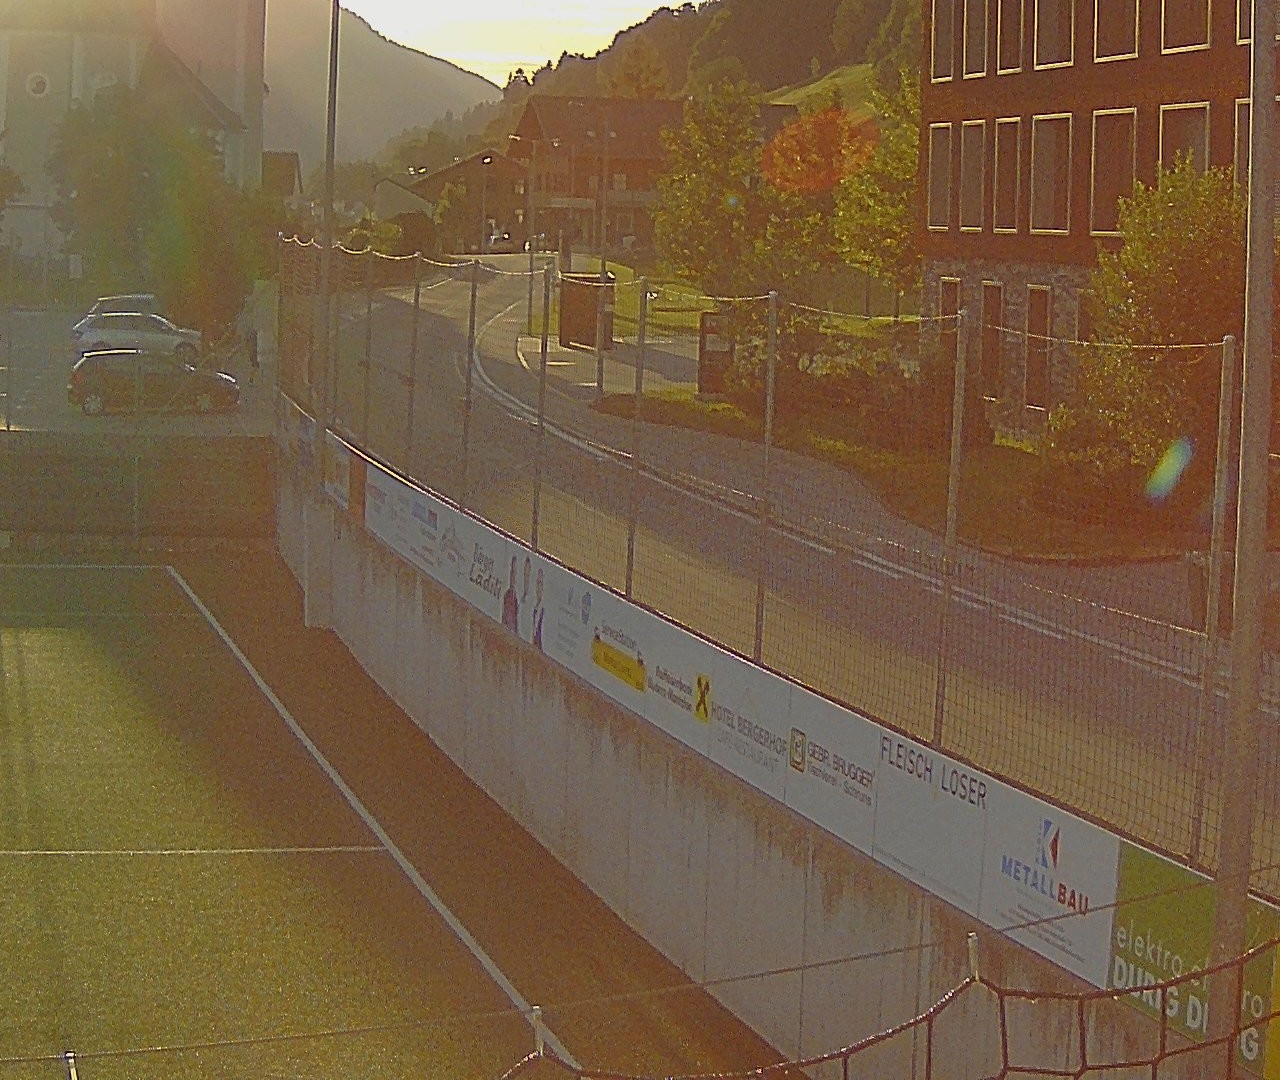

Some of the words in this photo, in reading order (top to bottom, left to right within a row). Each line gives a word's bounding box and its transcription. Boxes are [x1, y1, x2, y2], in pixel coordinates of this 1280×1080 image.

[881, 736, 933, 784] FLEISCH
[941, 764, 987, 810] LOSER
[1001, 854, 1089, 915] METALLBAU
[1116, 919, 1182, 976] elektro
